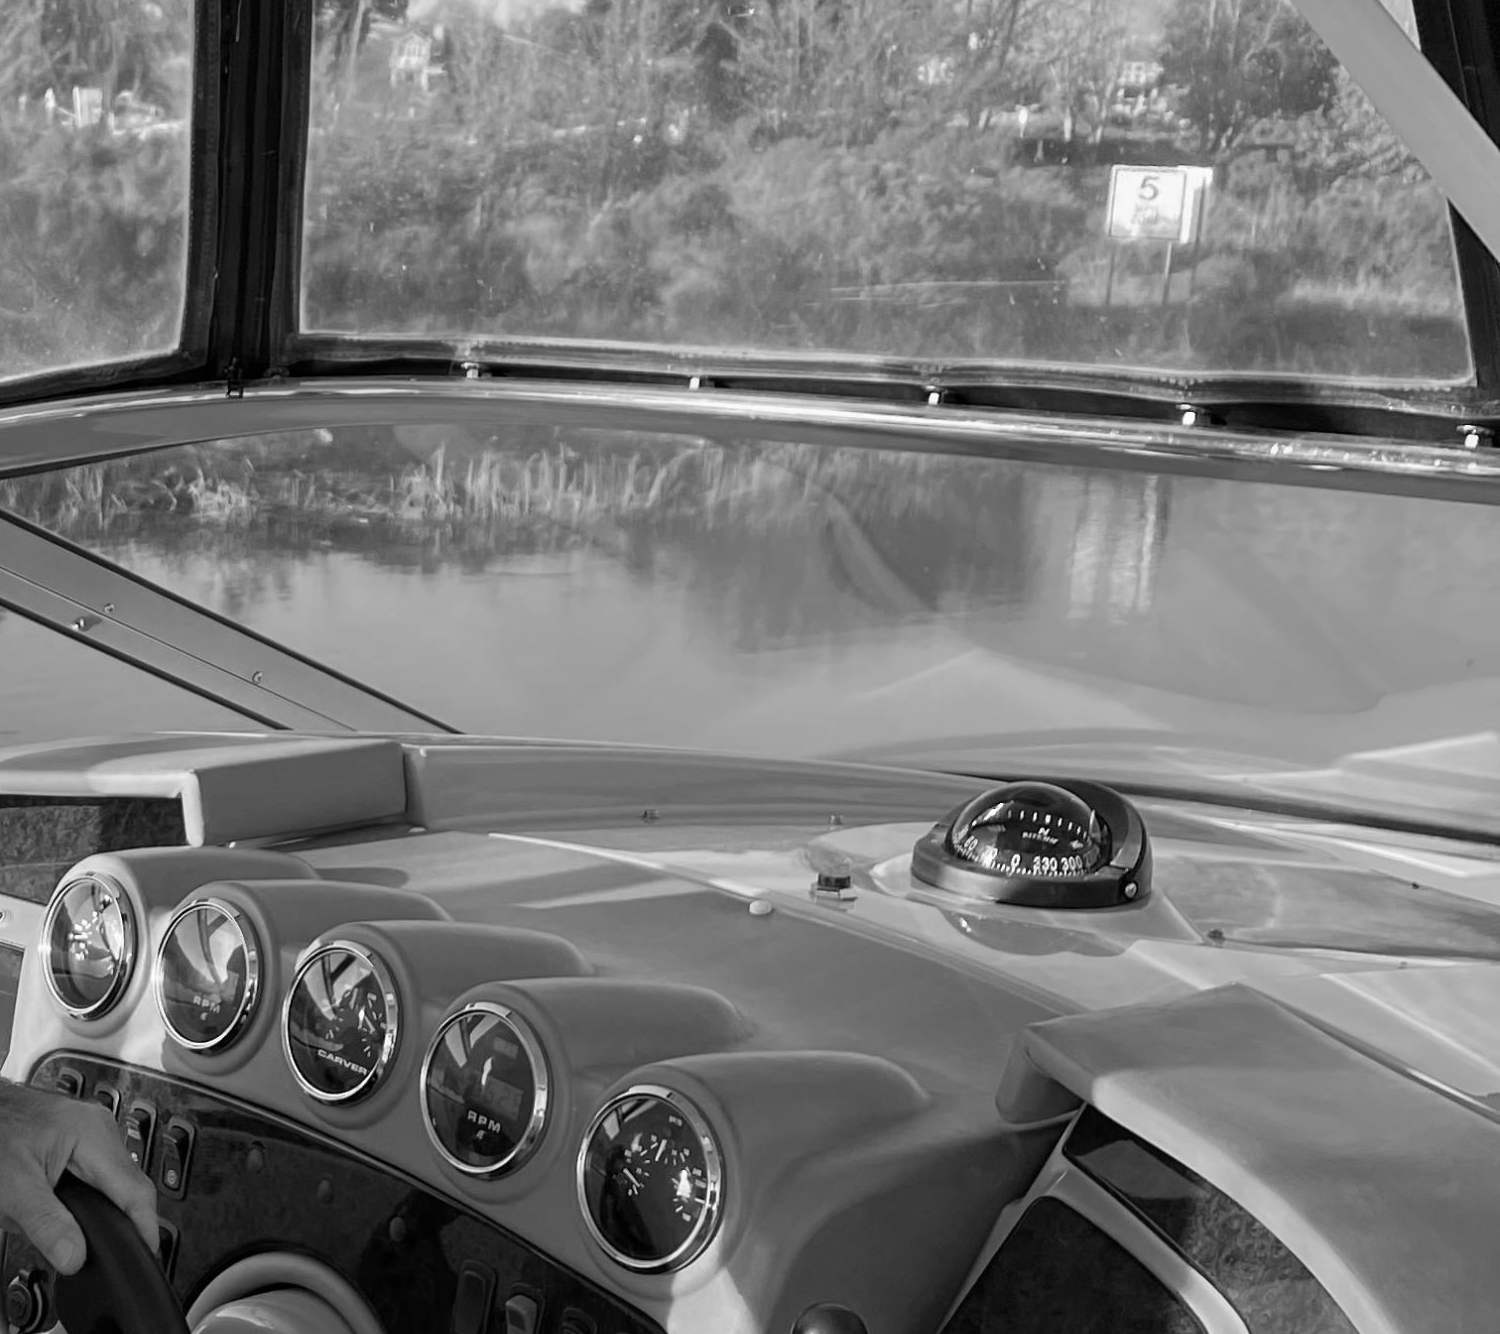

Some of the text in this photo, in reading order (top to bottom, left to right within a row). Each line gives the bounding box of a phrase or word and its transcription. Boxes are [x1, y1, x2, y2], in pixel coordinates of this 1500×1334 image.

[1138, 175, 1159, 201] 5
[1010, 853, 1021, 869] 0
[1060, 854, 1083, 871] 300
[192, 994, 221, 1014] RPM
[317, 1049, 368, 1076] CARVER
[467, 1109, 501, 1133] RPM
